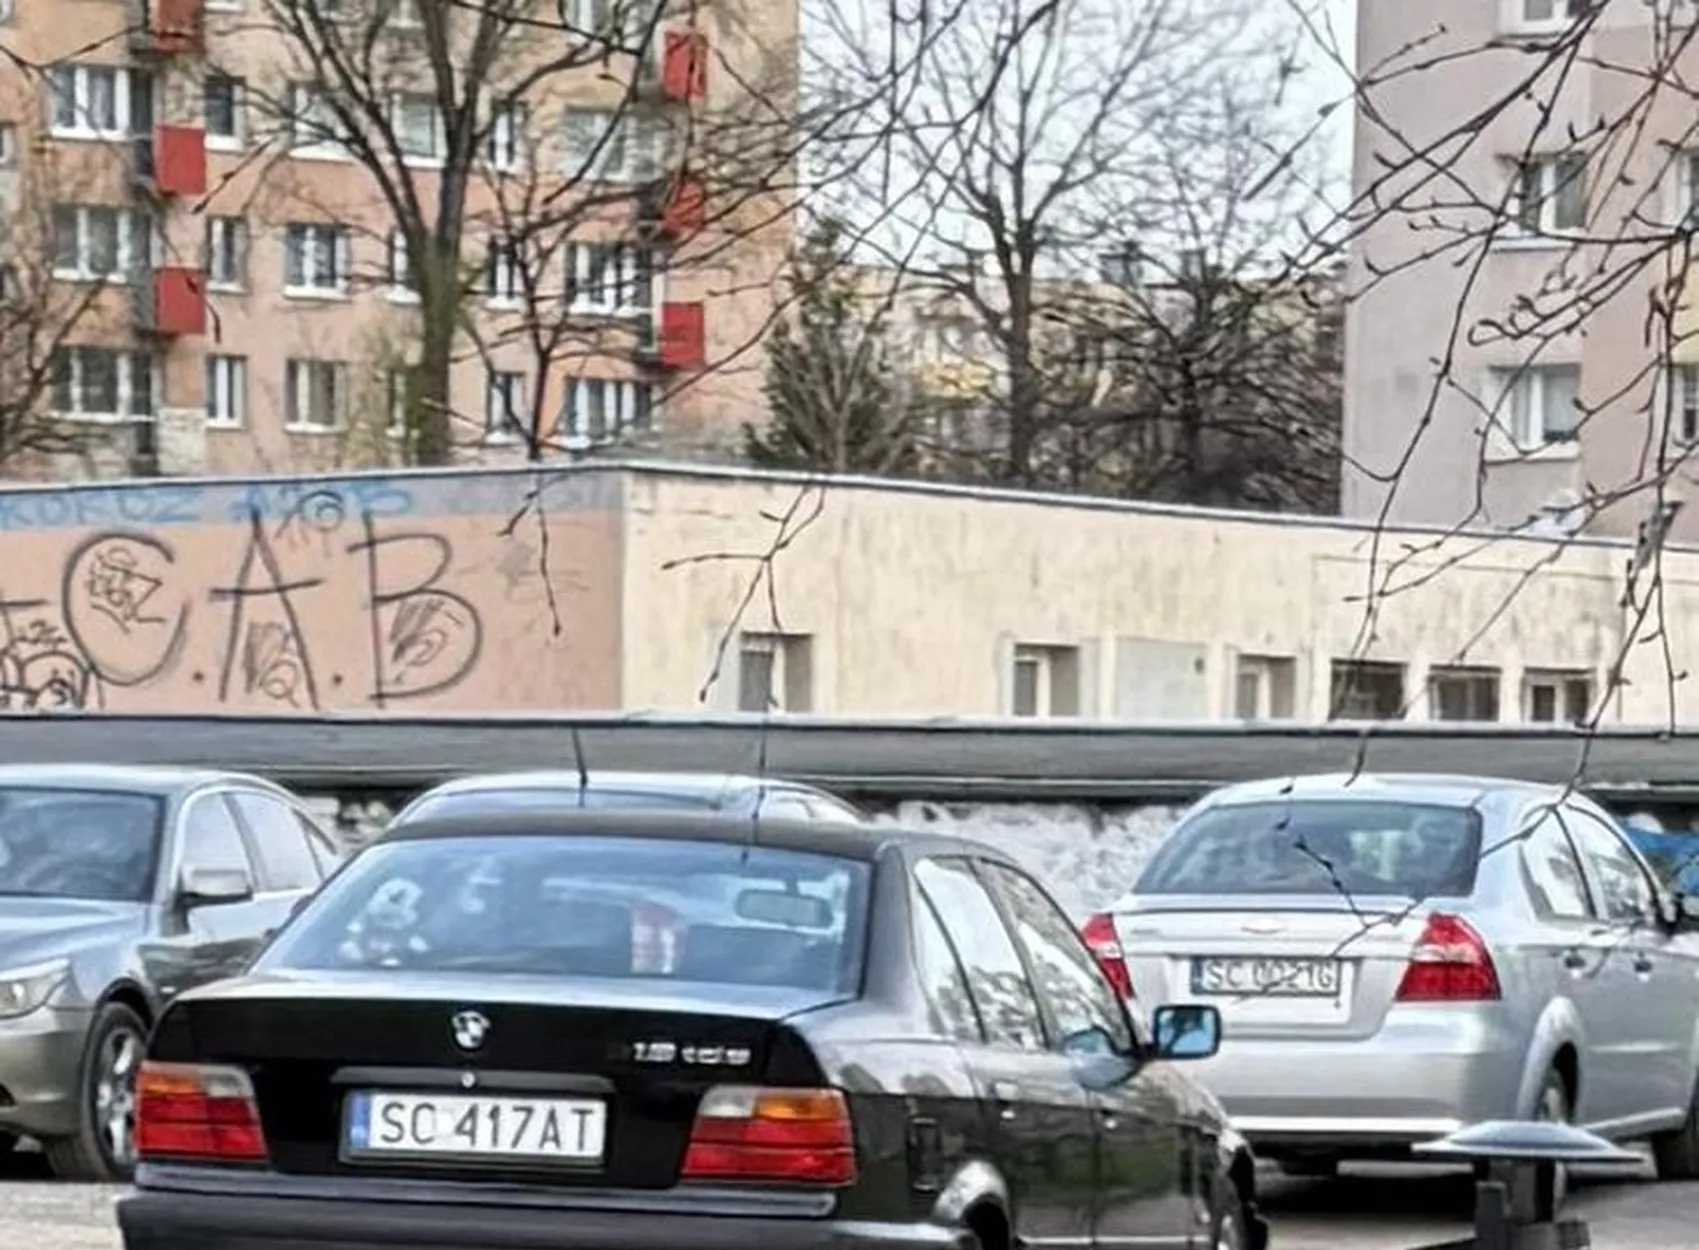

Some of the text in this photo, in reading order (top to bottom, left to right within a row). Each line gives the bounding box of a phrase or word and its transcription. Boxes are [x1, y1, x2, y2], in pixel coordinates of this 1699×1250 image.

[1208, 957, 1243, 989] SC
[380, 1101, 595, 1151] SC 417AT
